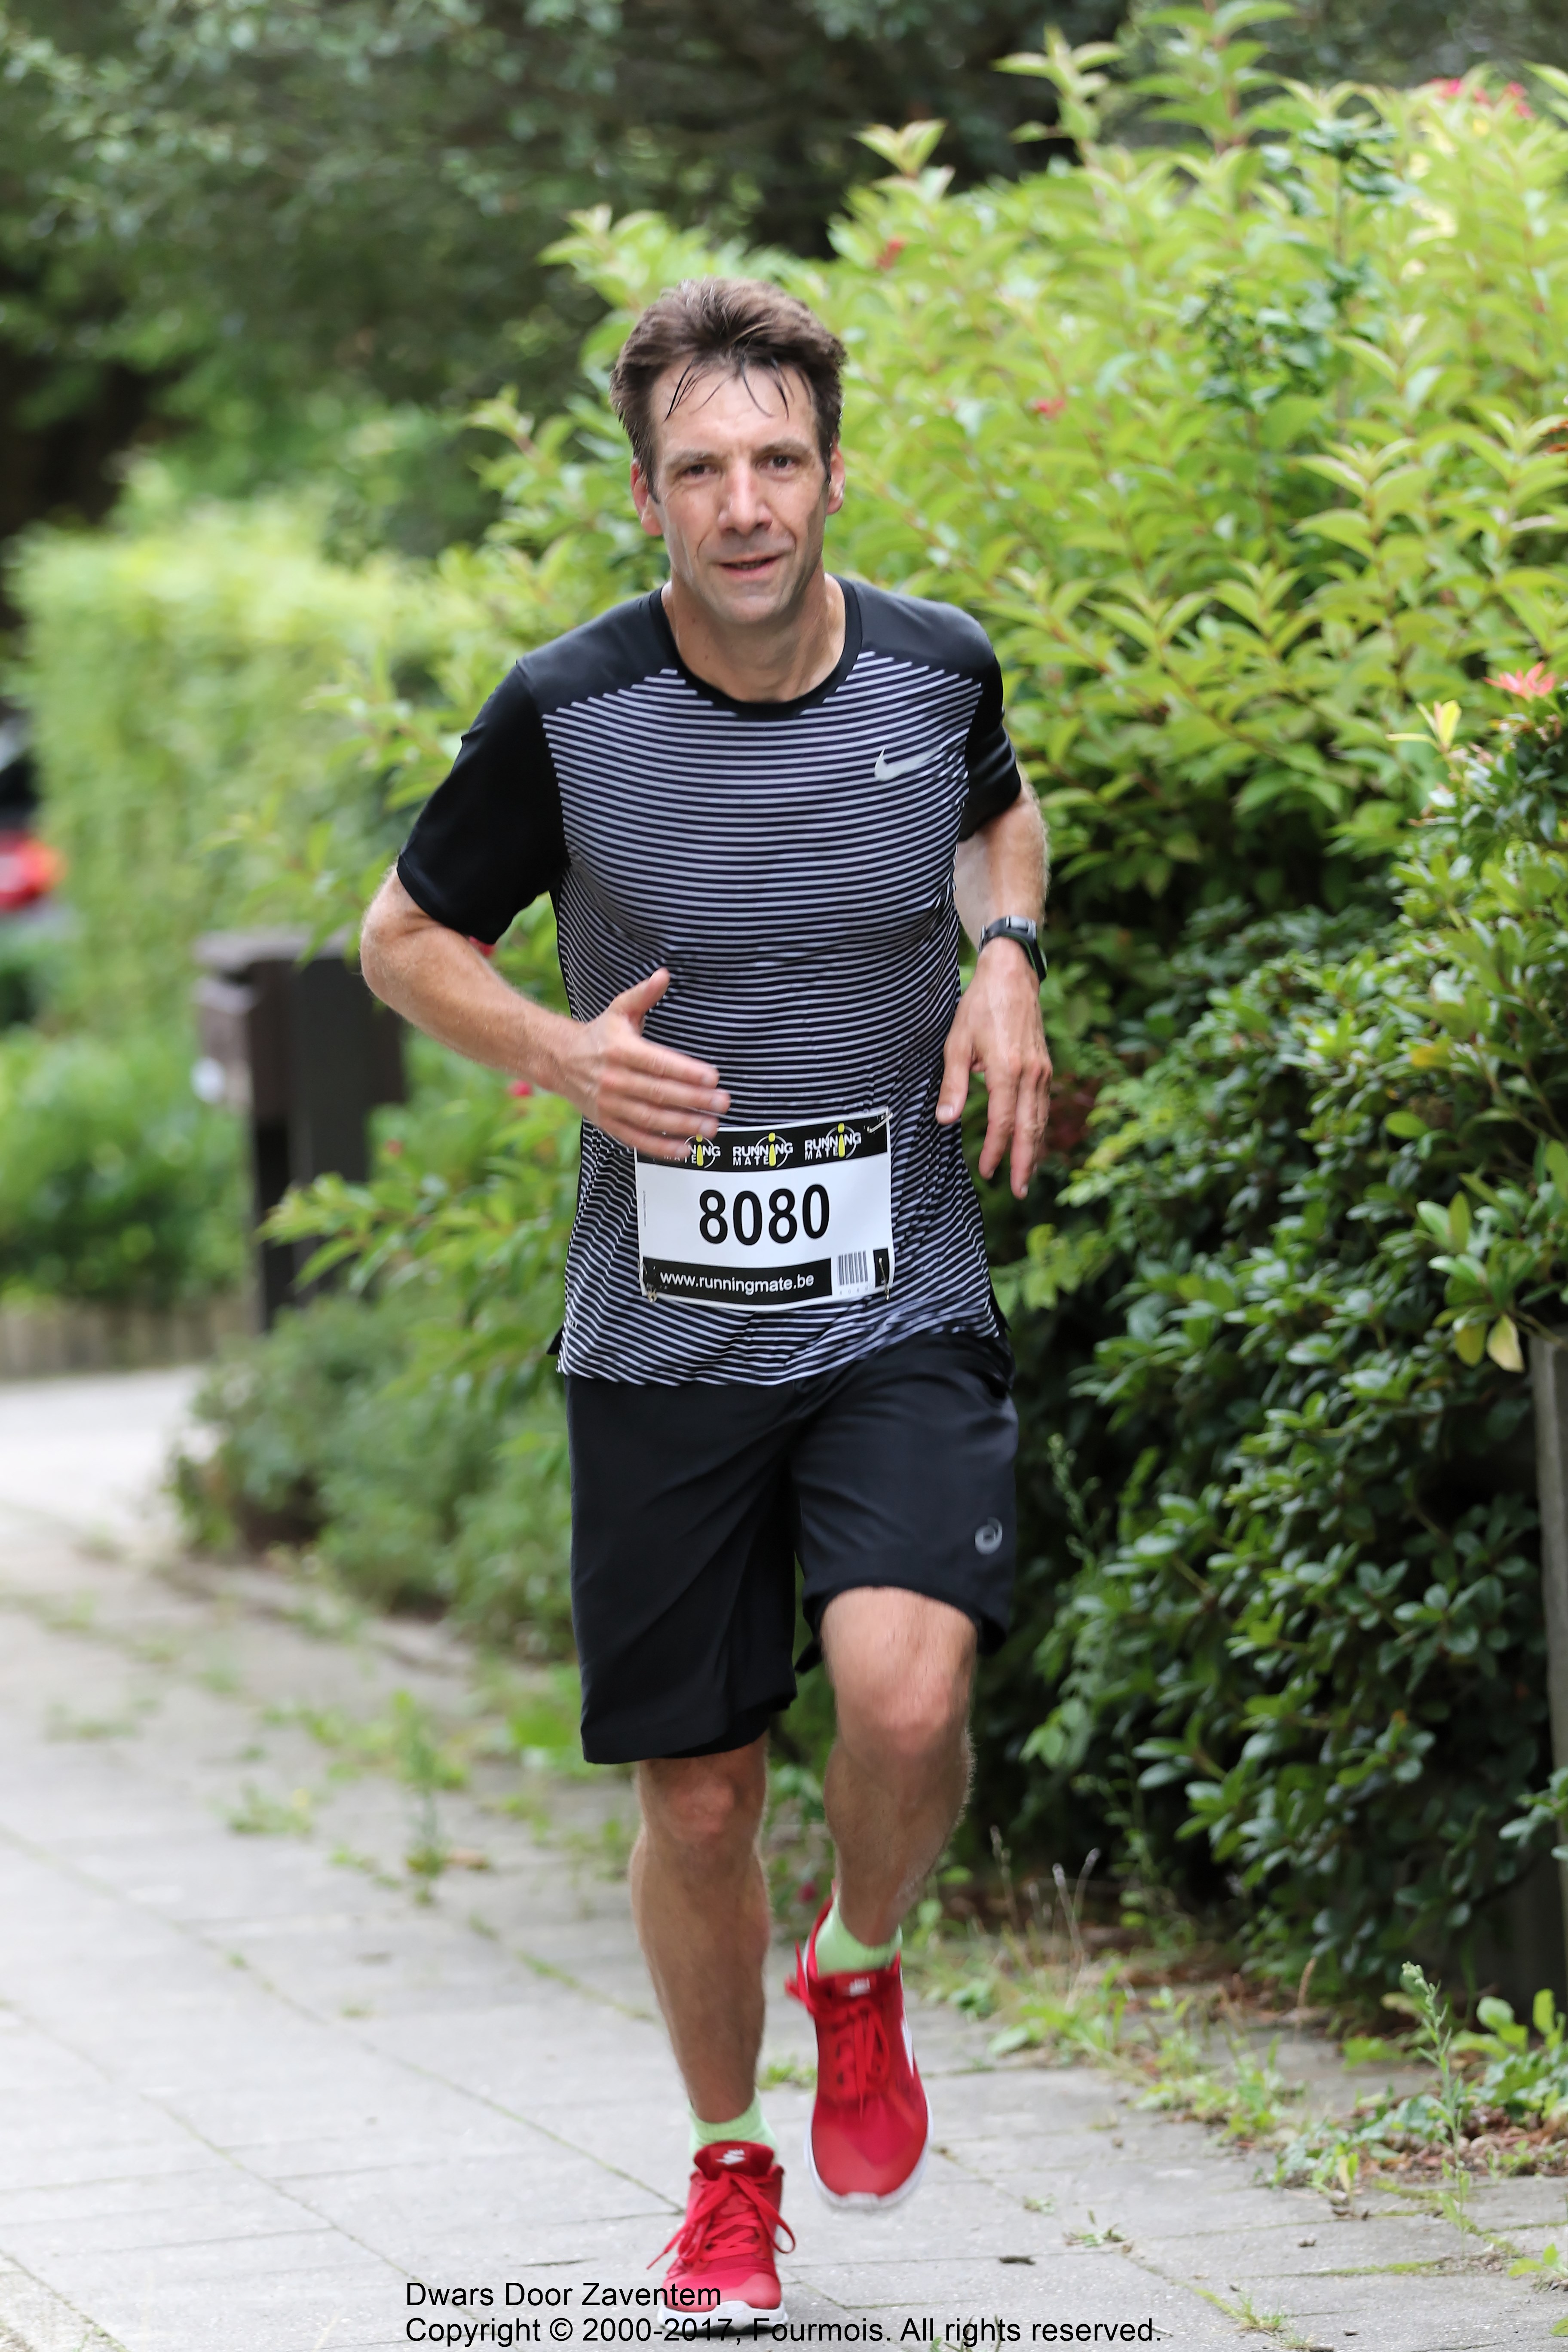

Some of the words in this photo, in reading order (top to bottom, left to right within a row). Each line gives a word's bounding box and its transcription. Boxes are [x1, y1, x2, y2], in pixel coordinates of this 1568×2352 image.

[732, 1135, 794, 1157] RUNNING
[805, 1125, 861, 1151] RUNNING
[733, 1155, 769, 1166] MATE
[805, 1146, 838, 1160] MATE
[699, 1184, 830, 1246] 8080
[660, 1274, 814, 1295] www.runningmate.be
